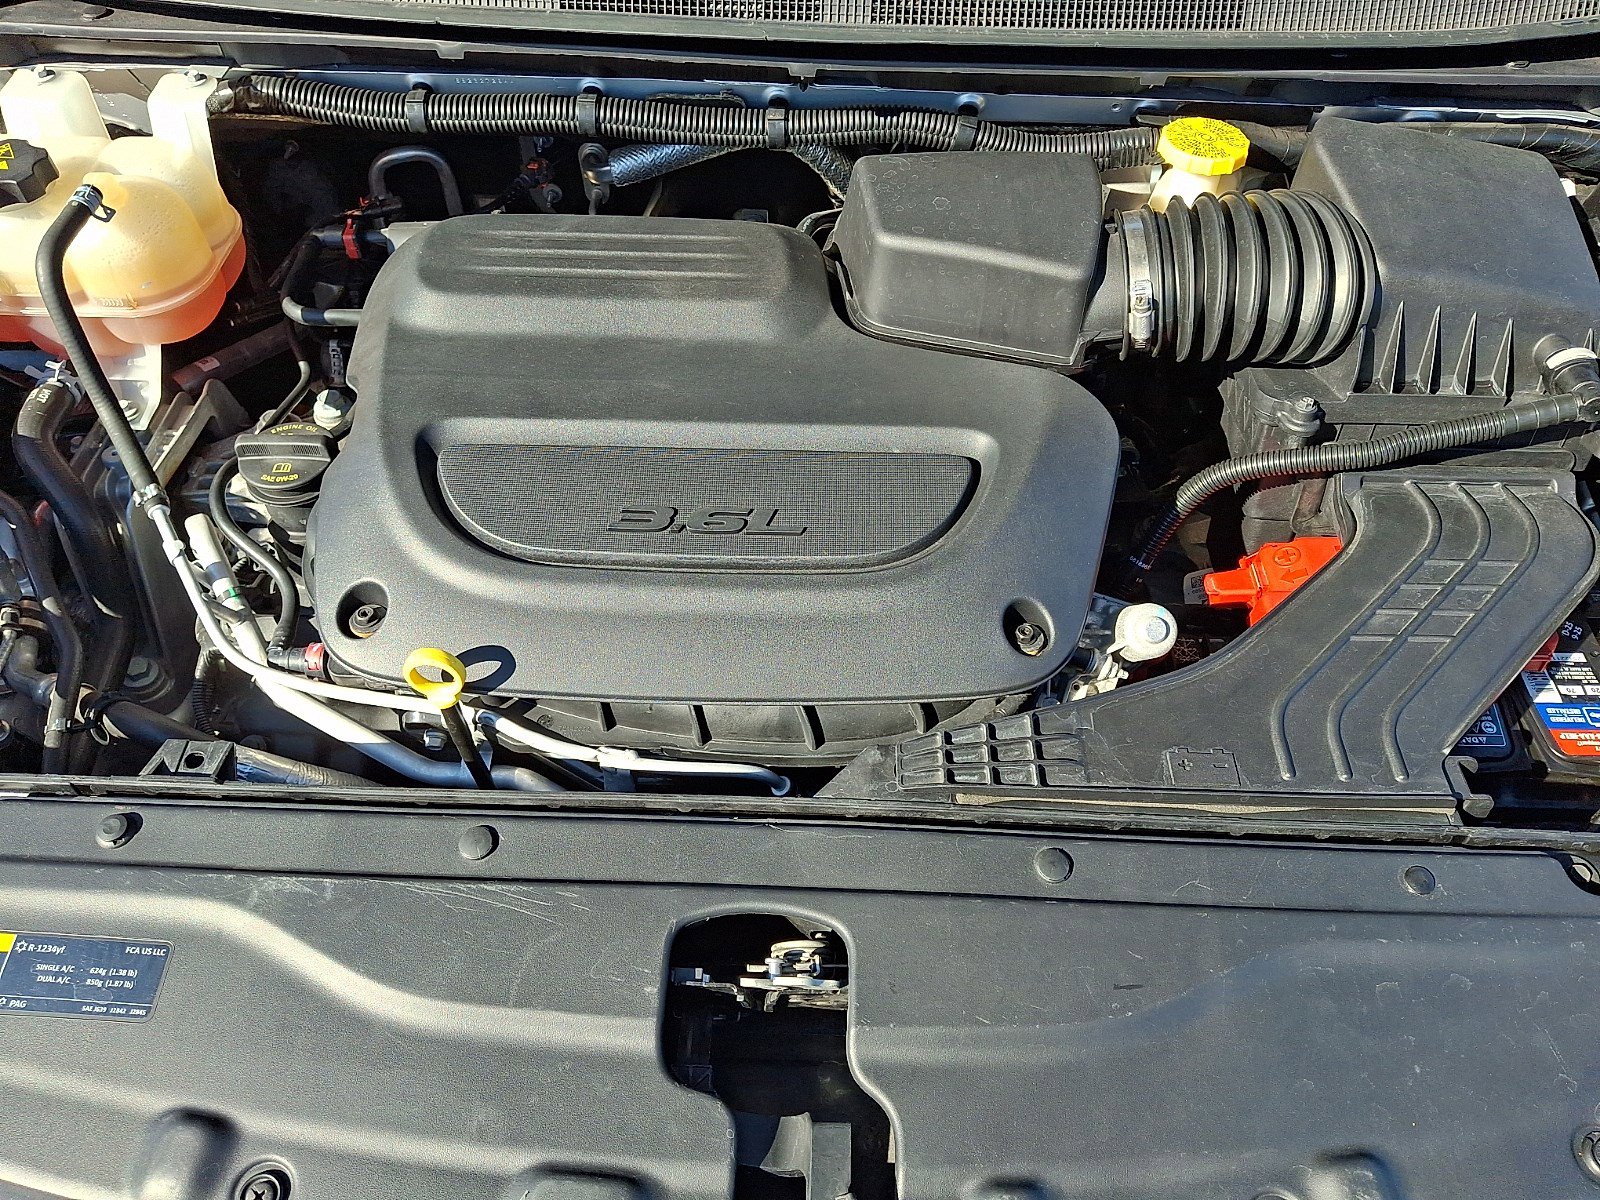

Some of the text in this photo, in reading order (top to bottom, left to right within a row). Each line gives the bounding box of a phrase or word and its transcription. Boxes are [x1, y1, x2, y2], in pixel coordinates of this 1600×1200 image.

[270, 424, 304, 434] ENGINE
[260, 474, 276, 482] SAE
[606, 503, 808, 536] 3.6L
[27, 943, 167, 956] R-1234yf FCA US LLC
[36, 963, 60, 972] SINGLE
[60, 965, 75, 974] A/C
[89, 967, 107, 976] 624g
[127, 969, 138, 978] lb)
[36, 975, 57, 983] DUAL
[56, 976, 72, 985] A/C
[85, 978, 103, 988] 850g
[123, 980, 134, 989] lb)
[9, 999, 28, 1008] PAG
